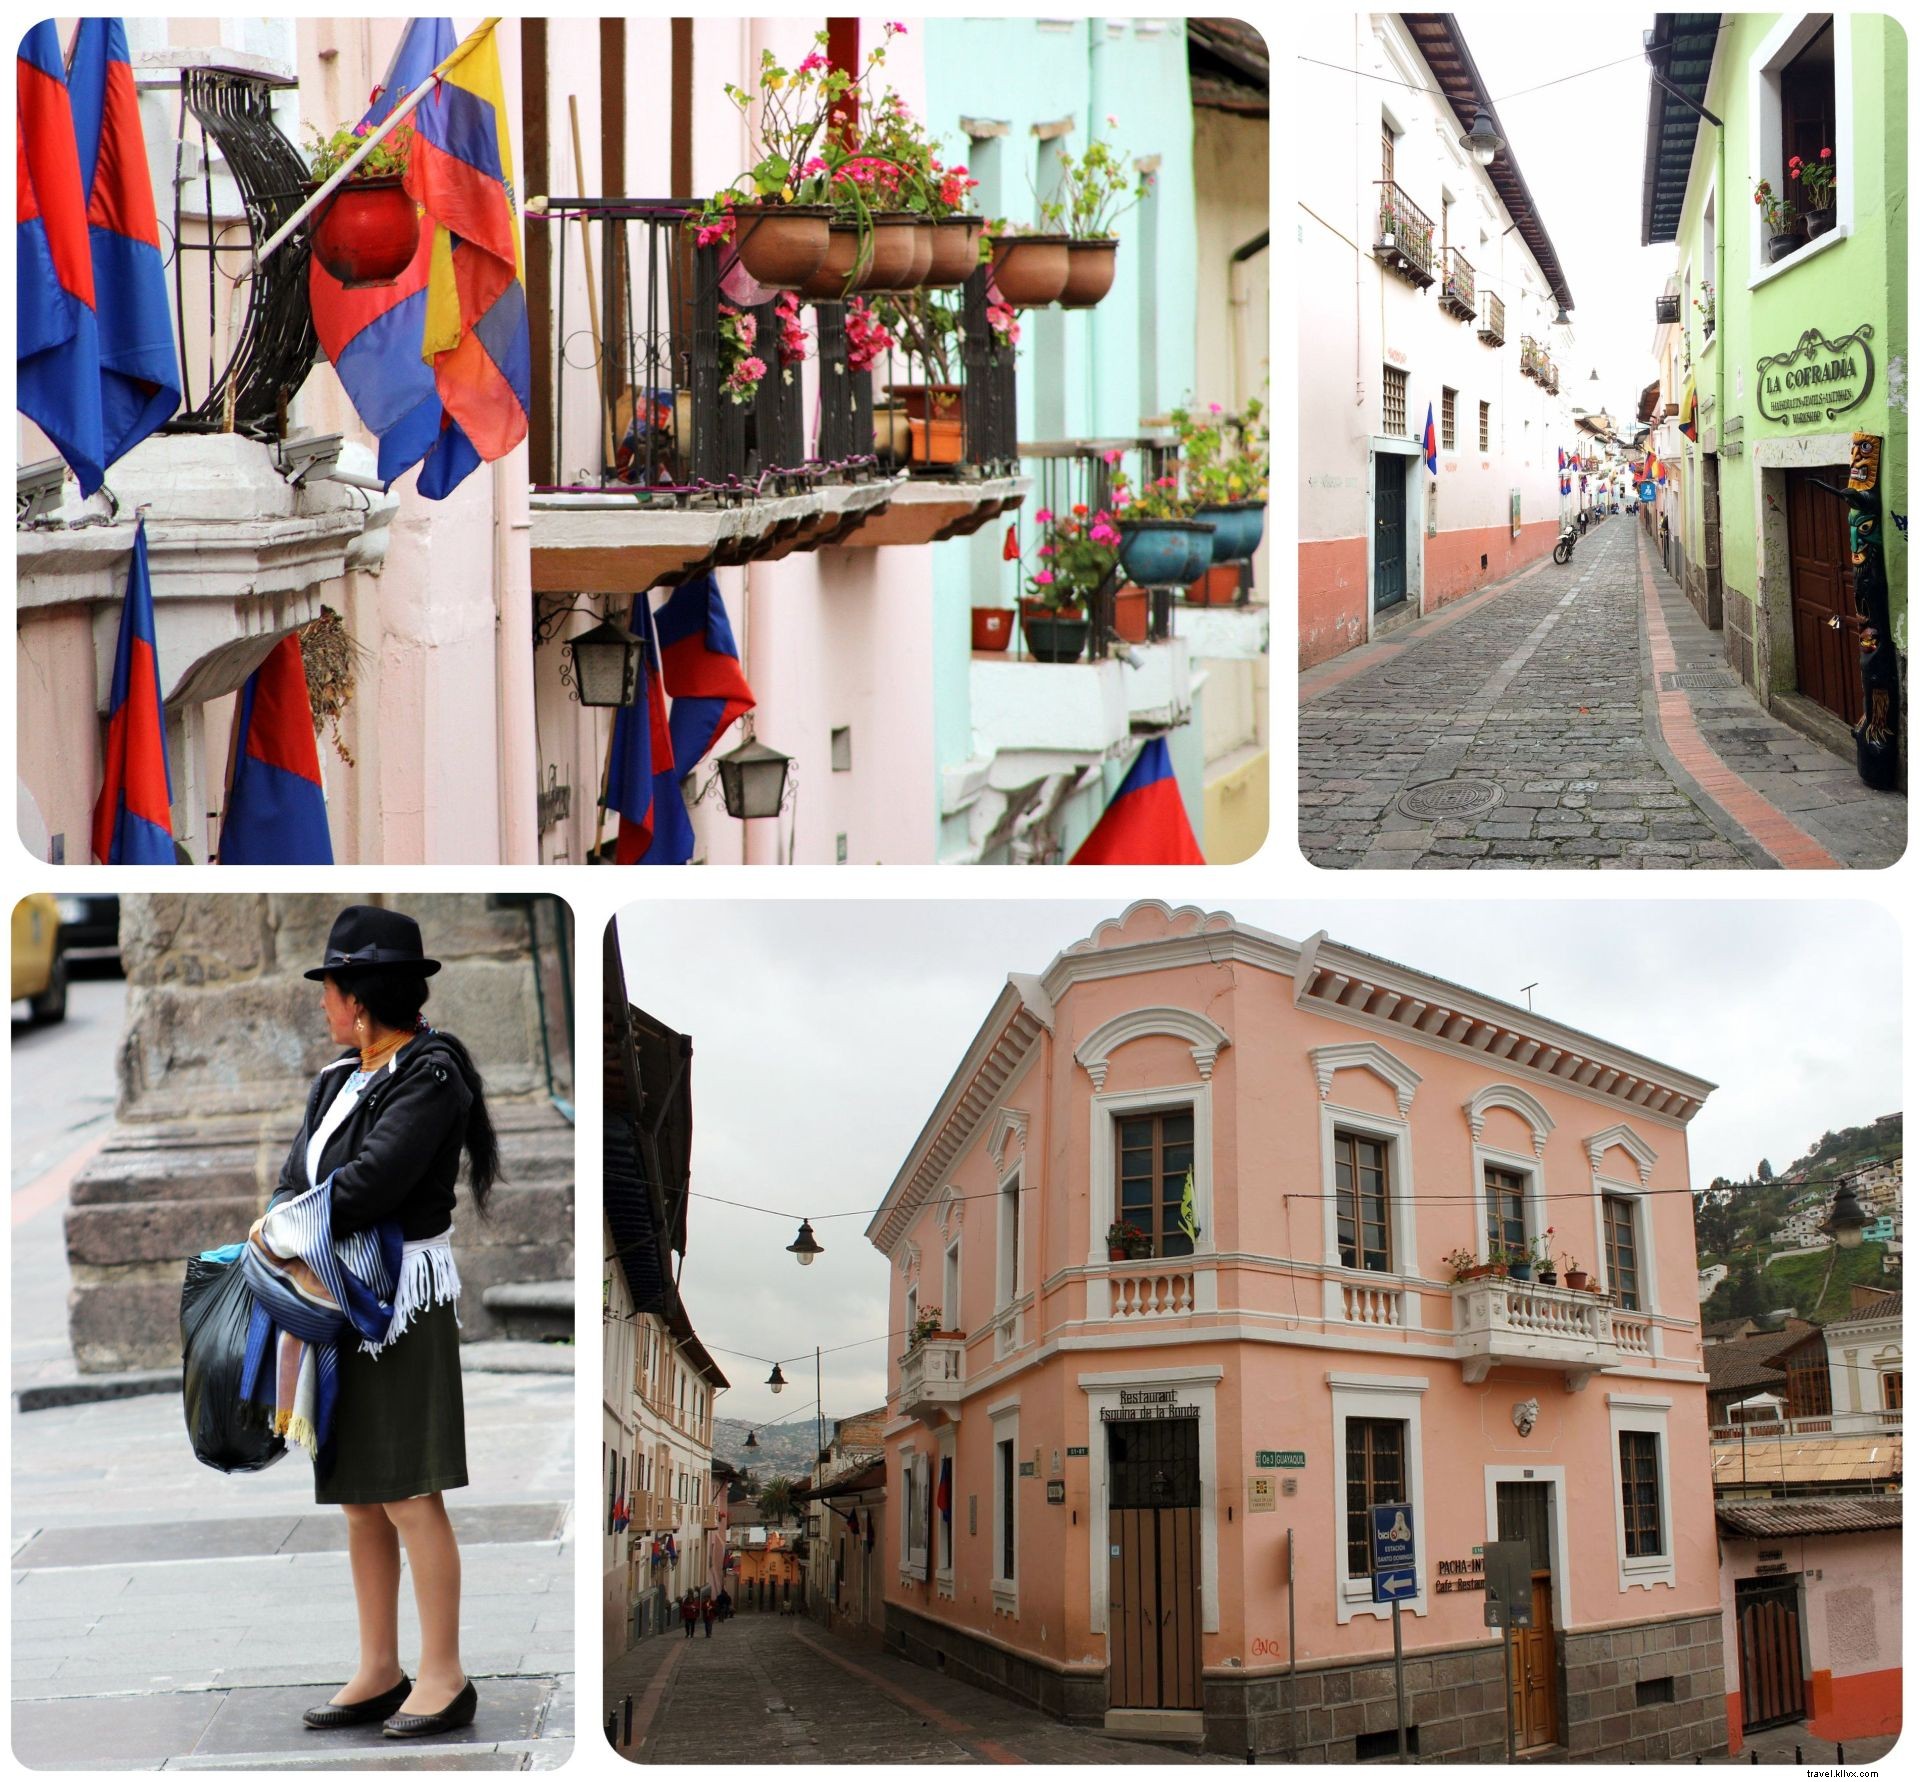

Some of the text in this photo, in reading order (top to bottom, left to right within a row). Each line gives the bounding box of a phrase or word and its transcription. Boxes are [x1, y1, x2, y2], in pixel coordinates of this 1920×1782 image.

[1766, 375, 1781, 394] LA
[1120, 1389, 1178, 1405] Restaurant
[1100, 1403, 1200, 1421] Esquina de la Ronda
[1276, 1454, 1305, 1465] GUAYAQUIL
